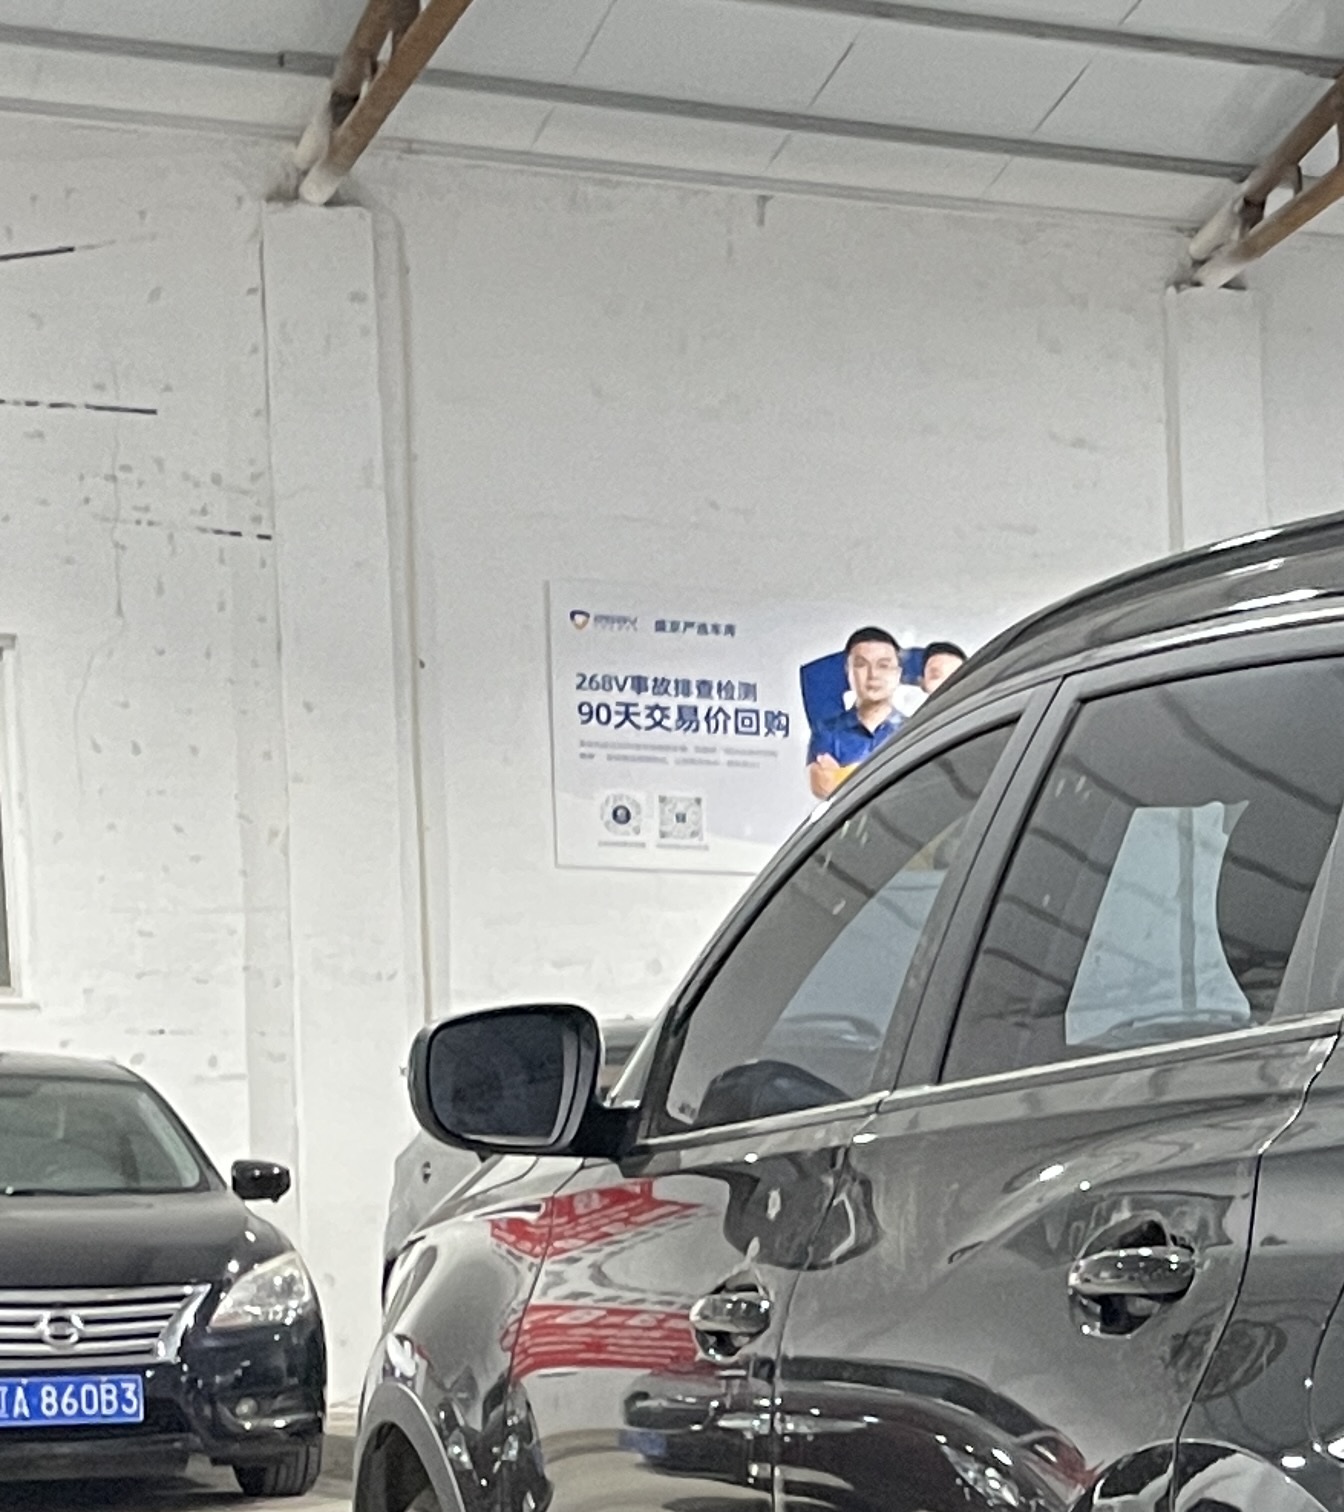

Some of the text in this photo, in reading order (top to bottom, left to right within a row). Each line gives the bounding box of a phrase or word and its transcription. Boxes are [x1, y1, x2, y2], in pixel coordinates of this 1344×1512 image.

[576, 673, 757, 702] 268V事故排查检测
[577, 701, 790, 737] 90天交易价回购
